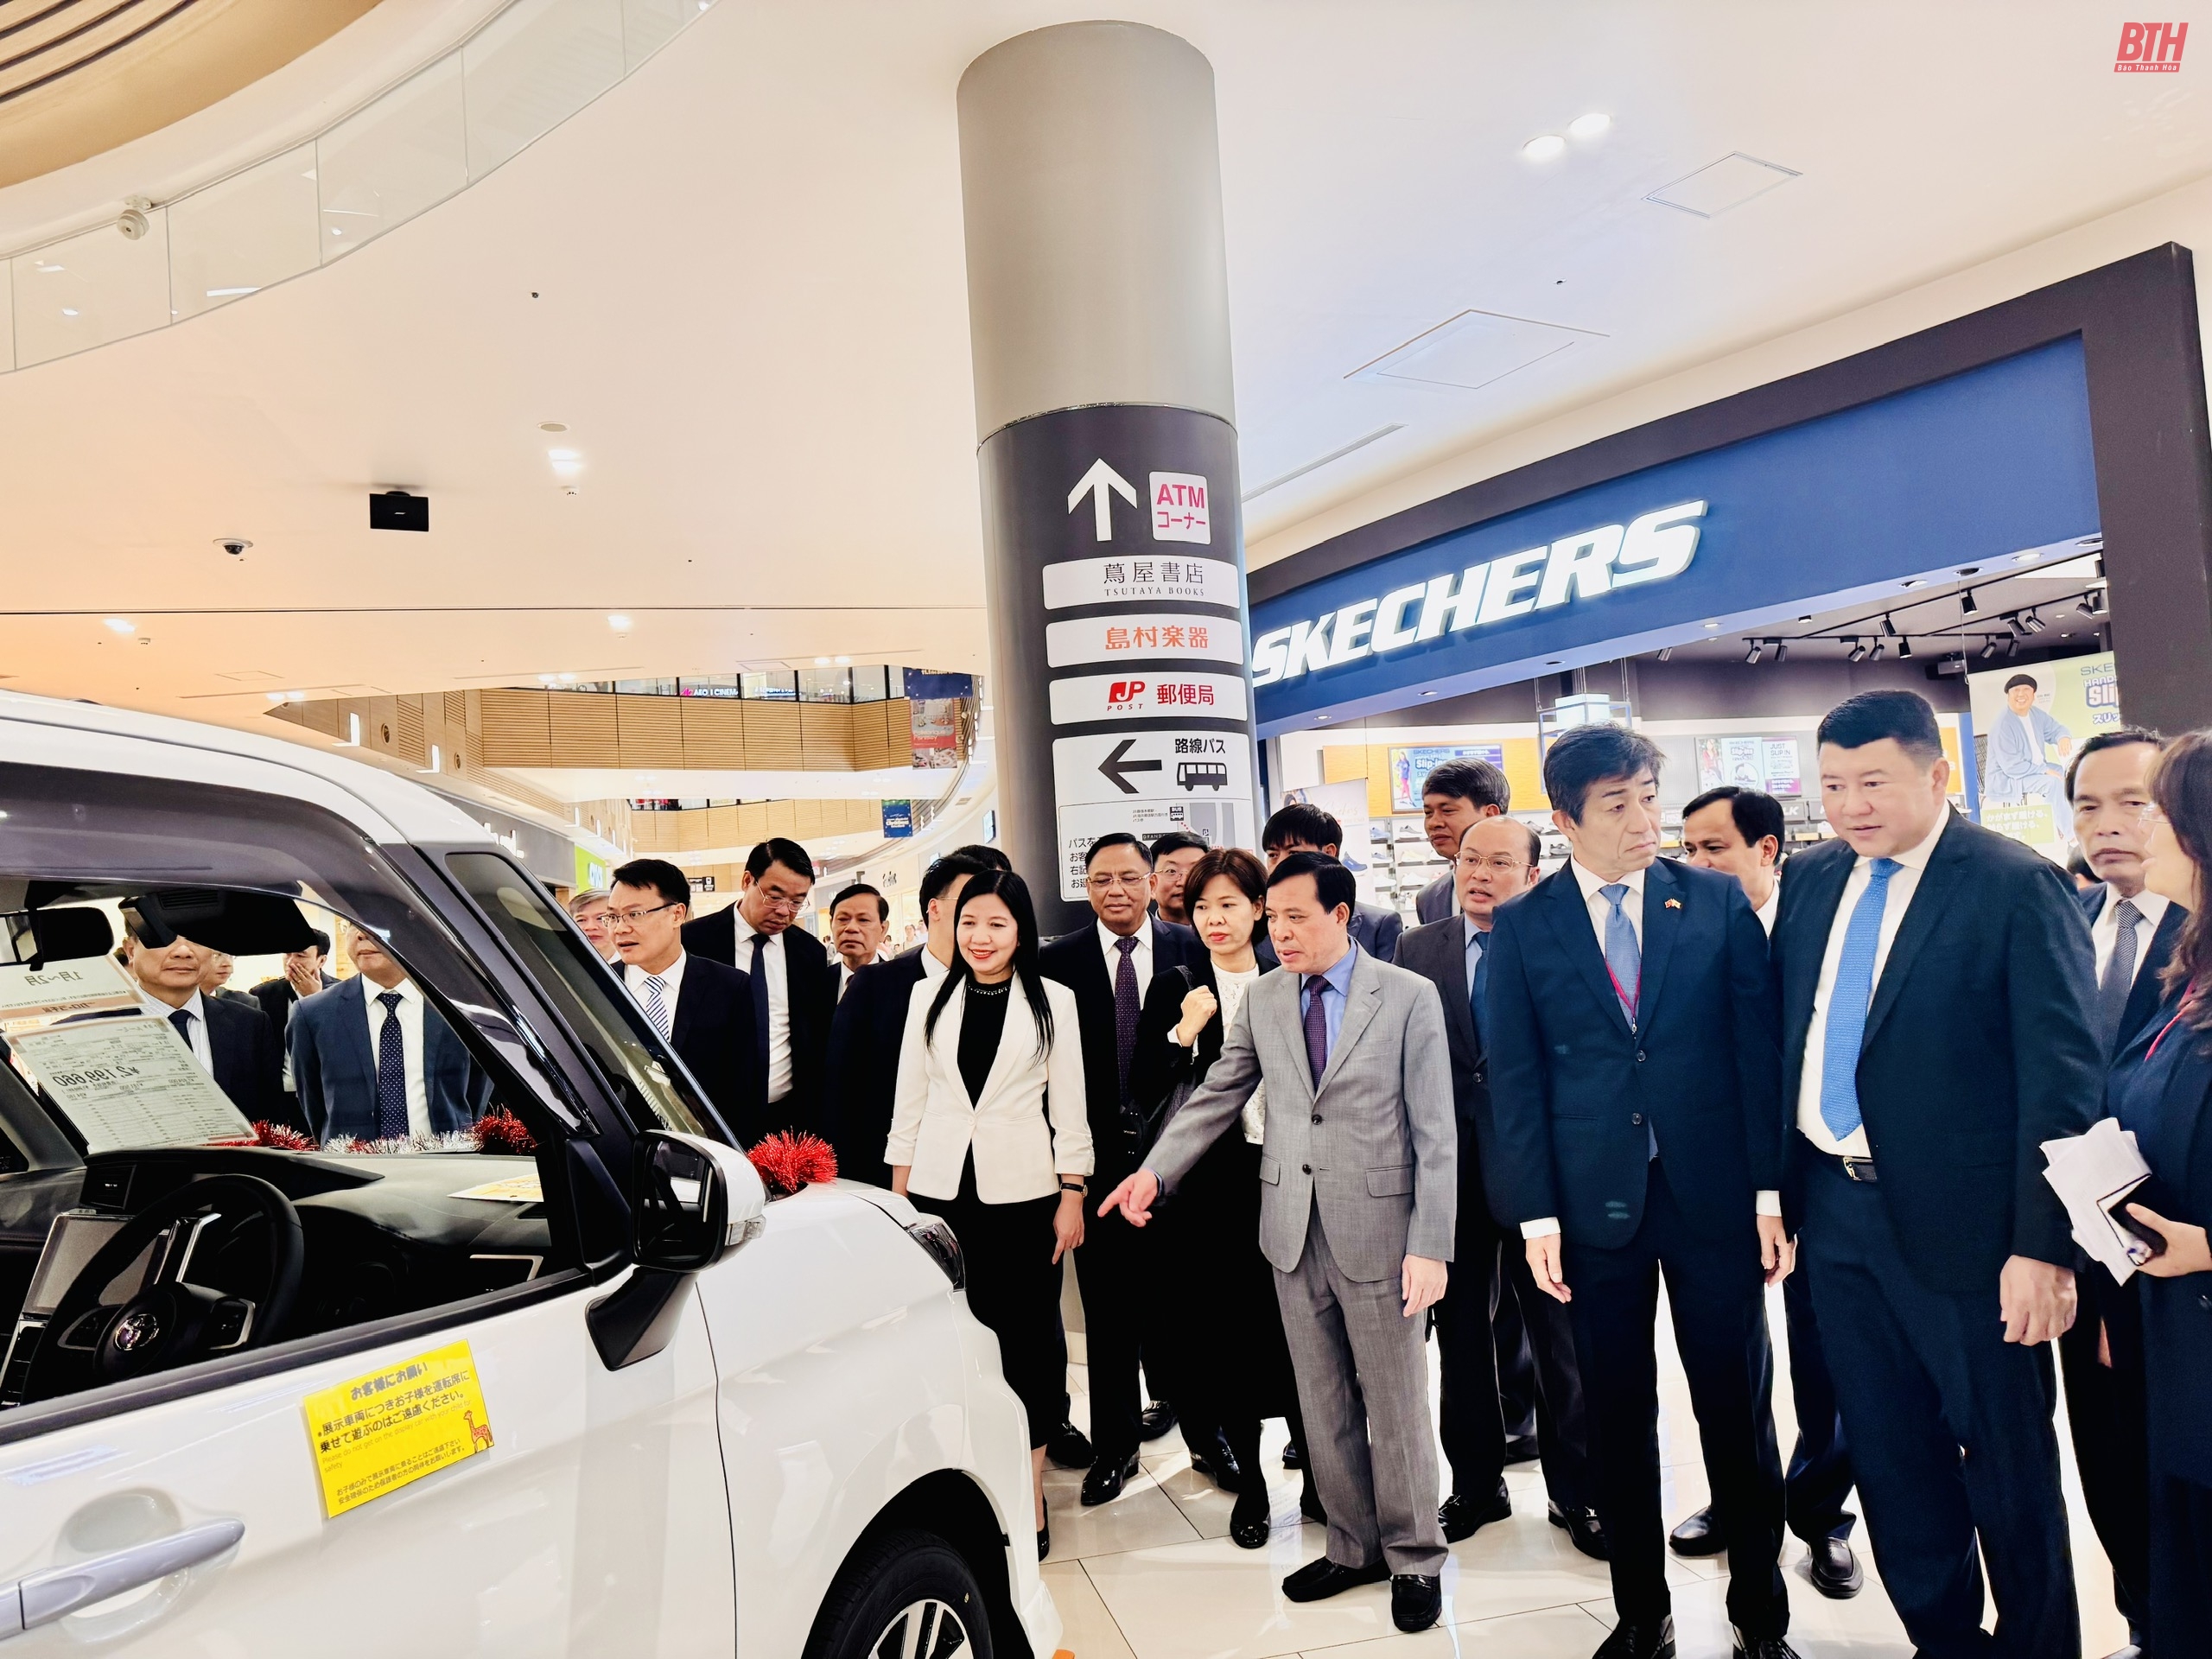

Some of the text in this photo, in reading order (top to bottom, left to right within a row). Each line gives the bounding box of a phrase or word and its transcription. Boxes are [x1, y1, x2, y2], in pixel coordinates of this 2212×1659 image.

[1156, 483, 1205, 509] ATM
[1157, 512, 1206, 530] コーナー
[1103, 561, 1204, 584] 蔦屋書店
[1104, 587, 1205, 596] TSUTAYA BOOKS
[1251, 499, 1709, 688] SKECHERS
[1105, 626, 1209, 650] 島村楽器
[2081, 662, 2114, 676] SKE
[1156, 683, 1215, 705] 郵便局
[1174, 738, 1226, 754] 路線バス
[351, 1361, 429, 1402] お客様にお願い
[320, 1390, 465, 1454] 乗せて遊ぶのはご遠慮ください。
